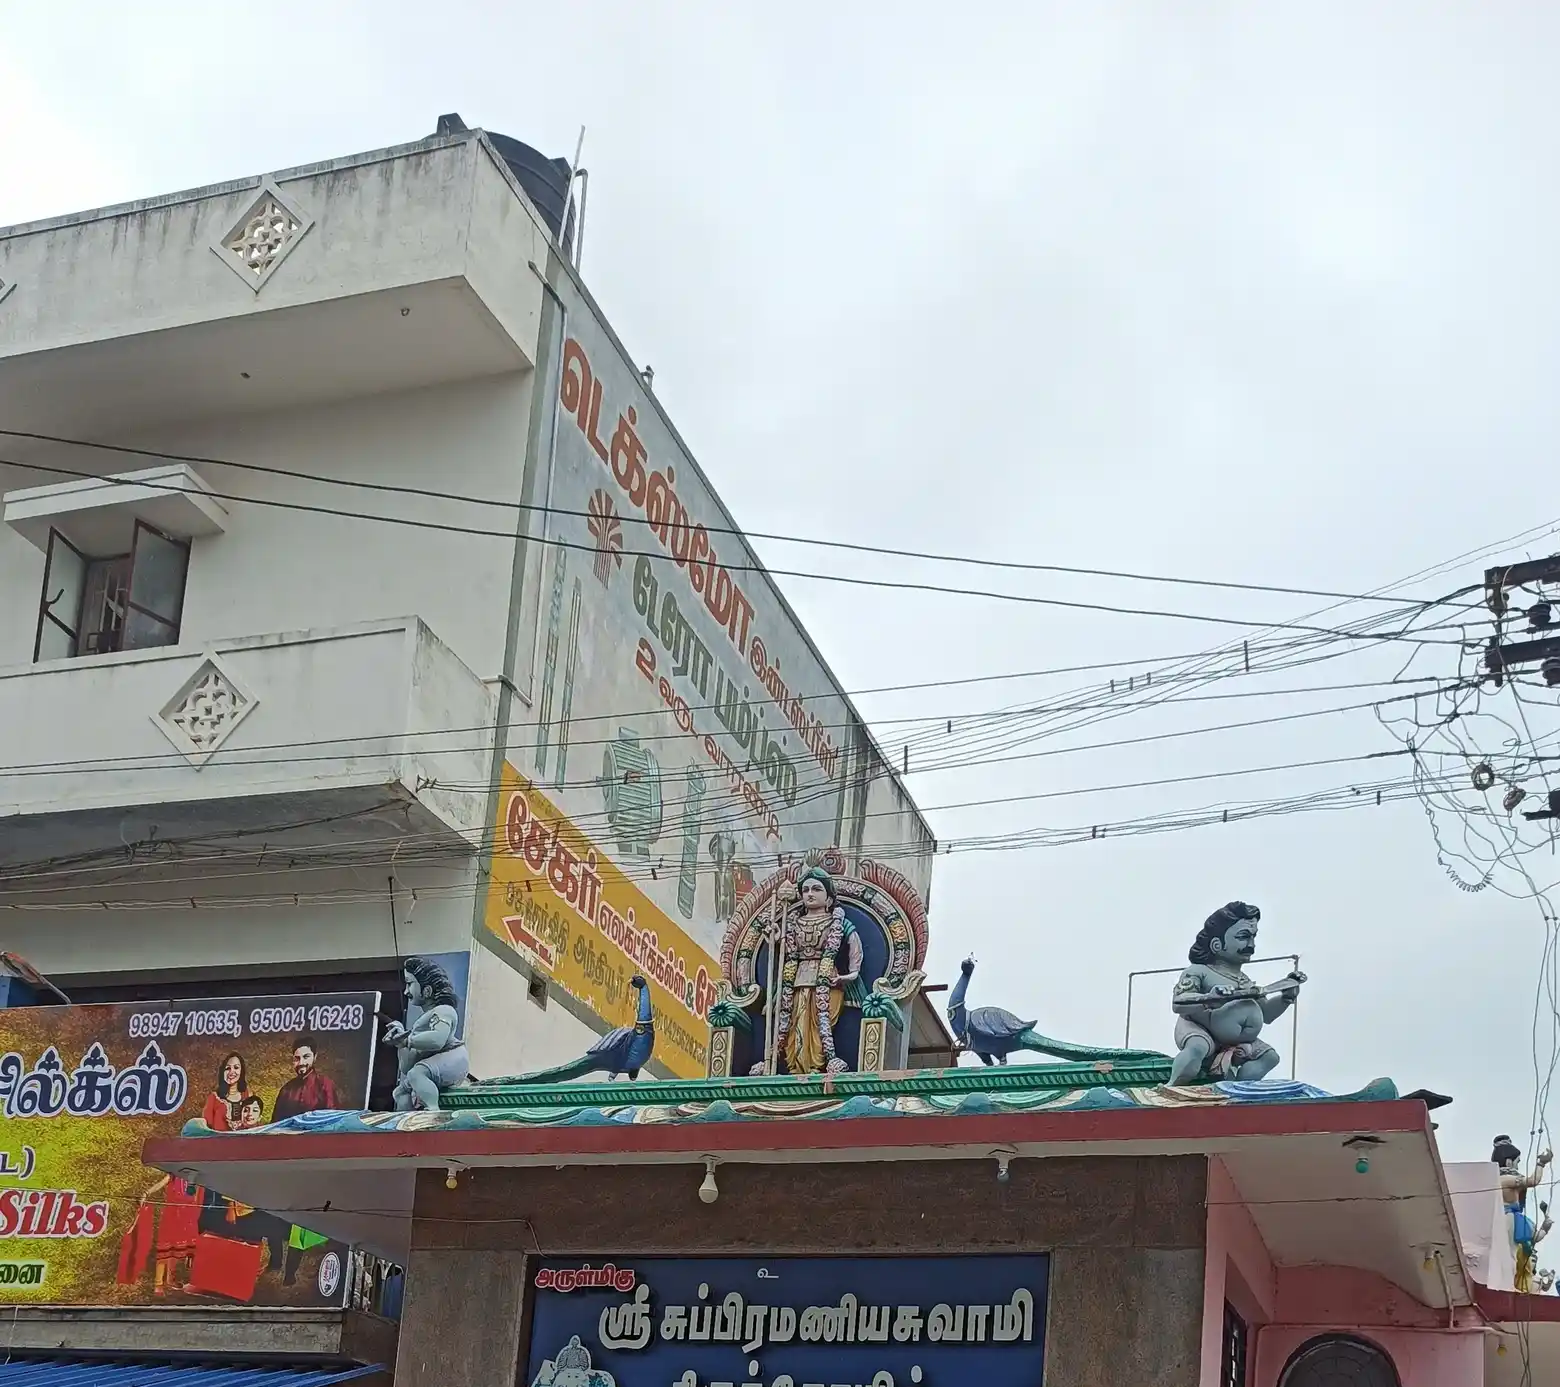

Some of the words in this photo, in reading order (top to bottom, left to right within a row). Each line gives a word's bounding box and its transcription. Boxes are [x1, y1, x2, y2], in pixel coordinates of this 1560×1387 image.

[129, 1012, 182, 1037] 98947
[184, 1010, 242, 1038] 10635,
[249, 1006, 305, 1033] 95004
[307, 1004, 363, 1030] 16248
[0, 1188, 109, 1238] Silks
[535, 1263, 635, 1292] அருள்மிகு
[599, 1284, 651, 1350] ஸ்ரீ
